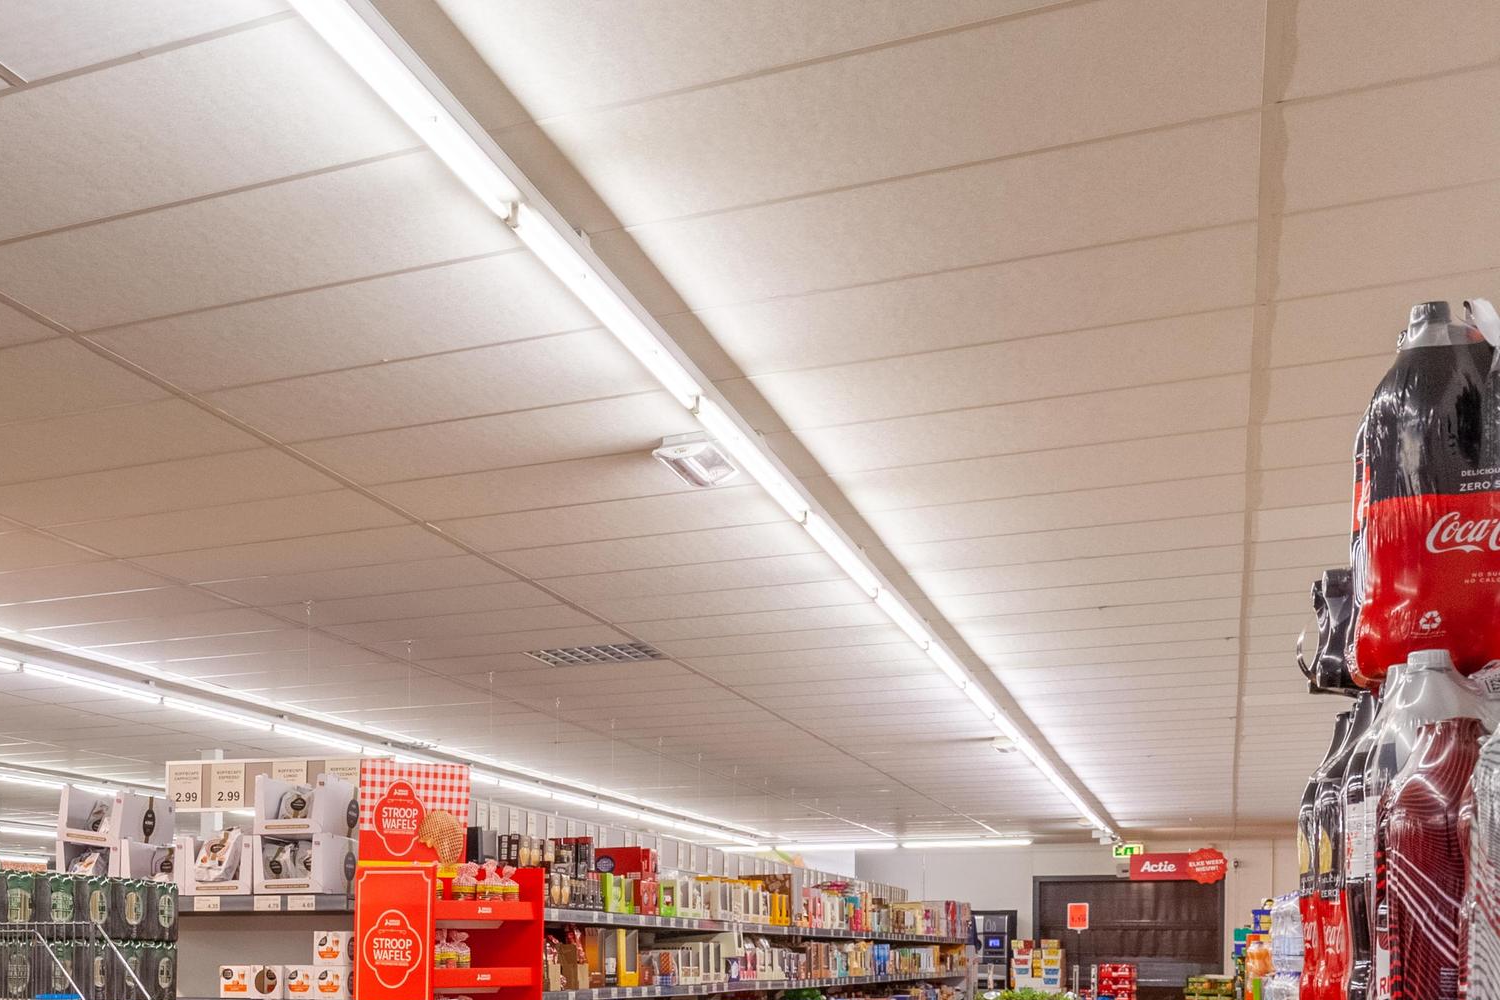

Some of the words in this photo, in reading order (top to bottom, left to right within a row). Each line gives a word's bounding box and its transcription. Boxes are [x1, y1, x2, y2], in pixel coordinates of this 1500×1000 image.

[1459, 481, 1491, 492] ZERO
[175, 792, 198, 802] 2.99
[217, 791, 240, 802] 2.99
[382, 807, 419, 819] STROOP
[382, 818, 417, 830] WAFELS
[1140, 861, 1177, 873] Actie
[1195, 865, 1219, 873] NIEUW!
[373, 937, 413, 950] STROOP
[373, 949, 412, 962] WAFELS
